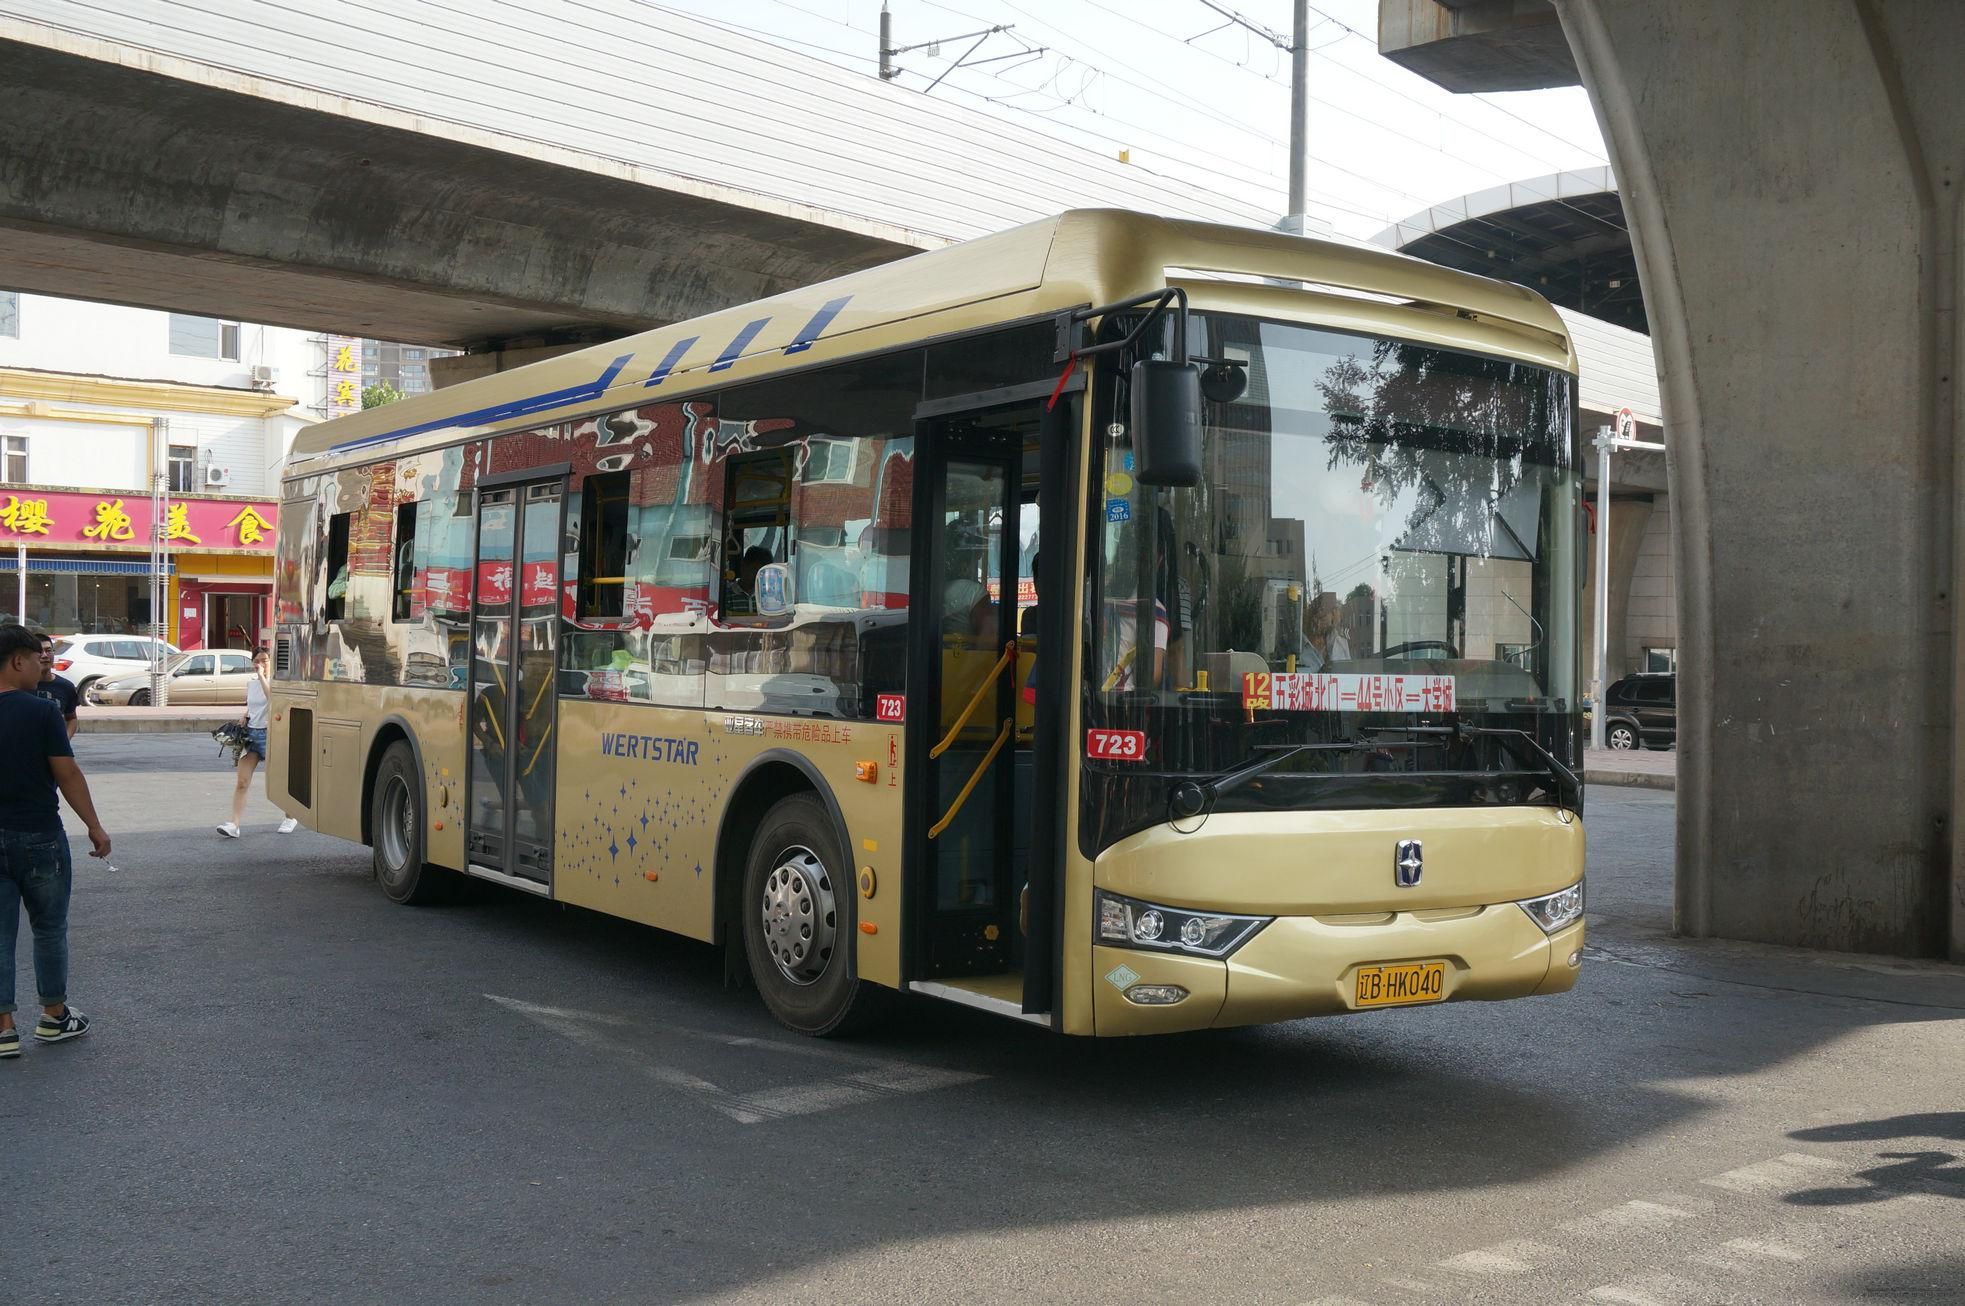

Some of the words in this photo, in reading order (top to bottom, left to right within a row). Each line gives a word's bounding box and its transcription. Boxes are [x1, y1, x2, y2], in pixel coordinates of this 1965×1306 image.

[1110, 512, 1129, 521] 2016
[1245, 672, 1270, 696] 12
[881, 699, 901, 717] 723
[601, 731, 699, 766] WERTSTAR
[1095, 734, 1137, 755] 723
[888, 771, 897, 787] 上
[1113, 972, 1134, 982] LNG
